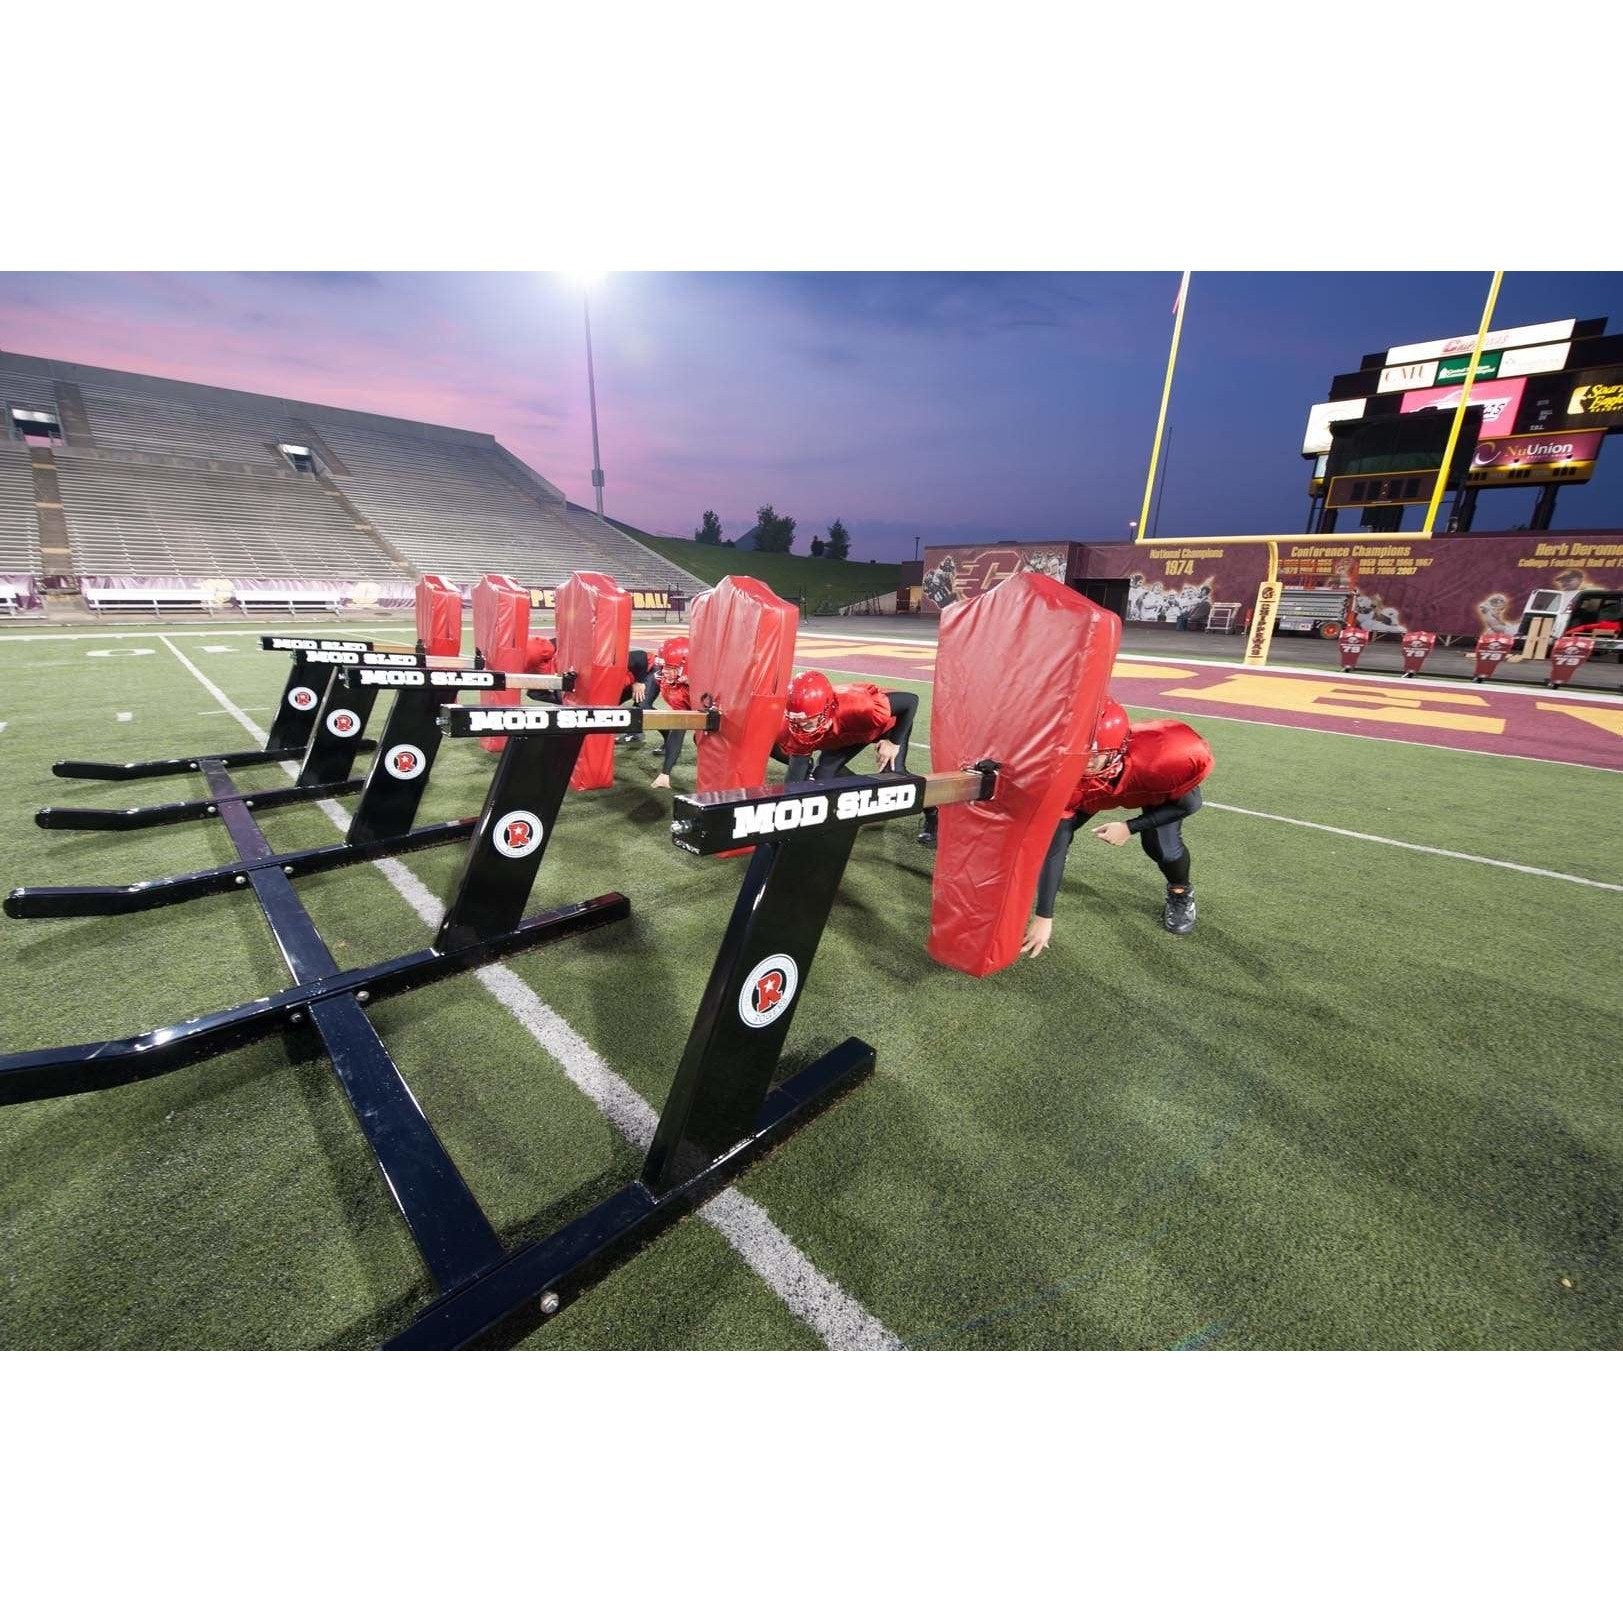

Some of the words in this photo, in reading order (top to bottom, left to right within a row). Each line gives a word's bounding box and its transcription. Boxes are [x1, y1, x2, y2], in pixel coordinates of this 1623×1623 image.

[1506, 443, 1573, 456] NuUnion
[1291, 546, 1350, 558] Conference
[1351, 545, 1411, 558] Champions
[1535, 543, 1569, 556] Herb
[1165, 560, 1194, 575] 1974
[273, 638, 317, 650] MOD
[321, 641, 367, 652] SLED
[306, 650, 359, 663] MOD
[363, 653, 417, 666] SLED
[360, 670, 424, 685] MOD
[430, 672, 494, 686] SLED
[470, 710, 549, 731] MOD
[556, 709, 631, 728] SLED
[732, 795, 828, 839] MOD
[835, 783, 916, 820] SLED
